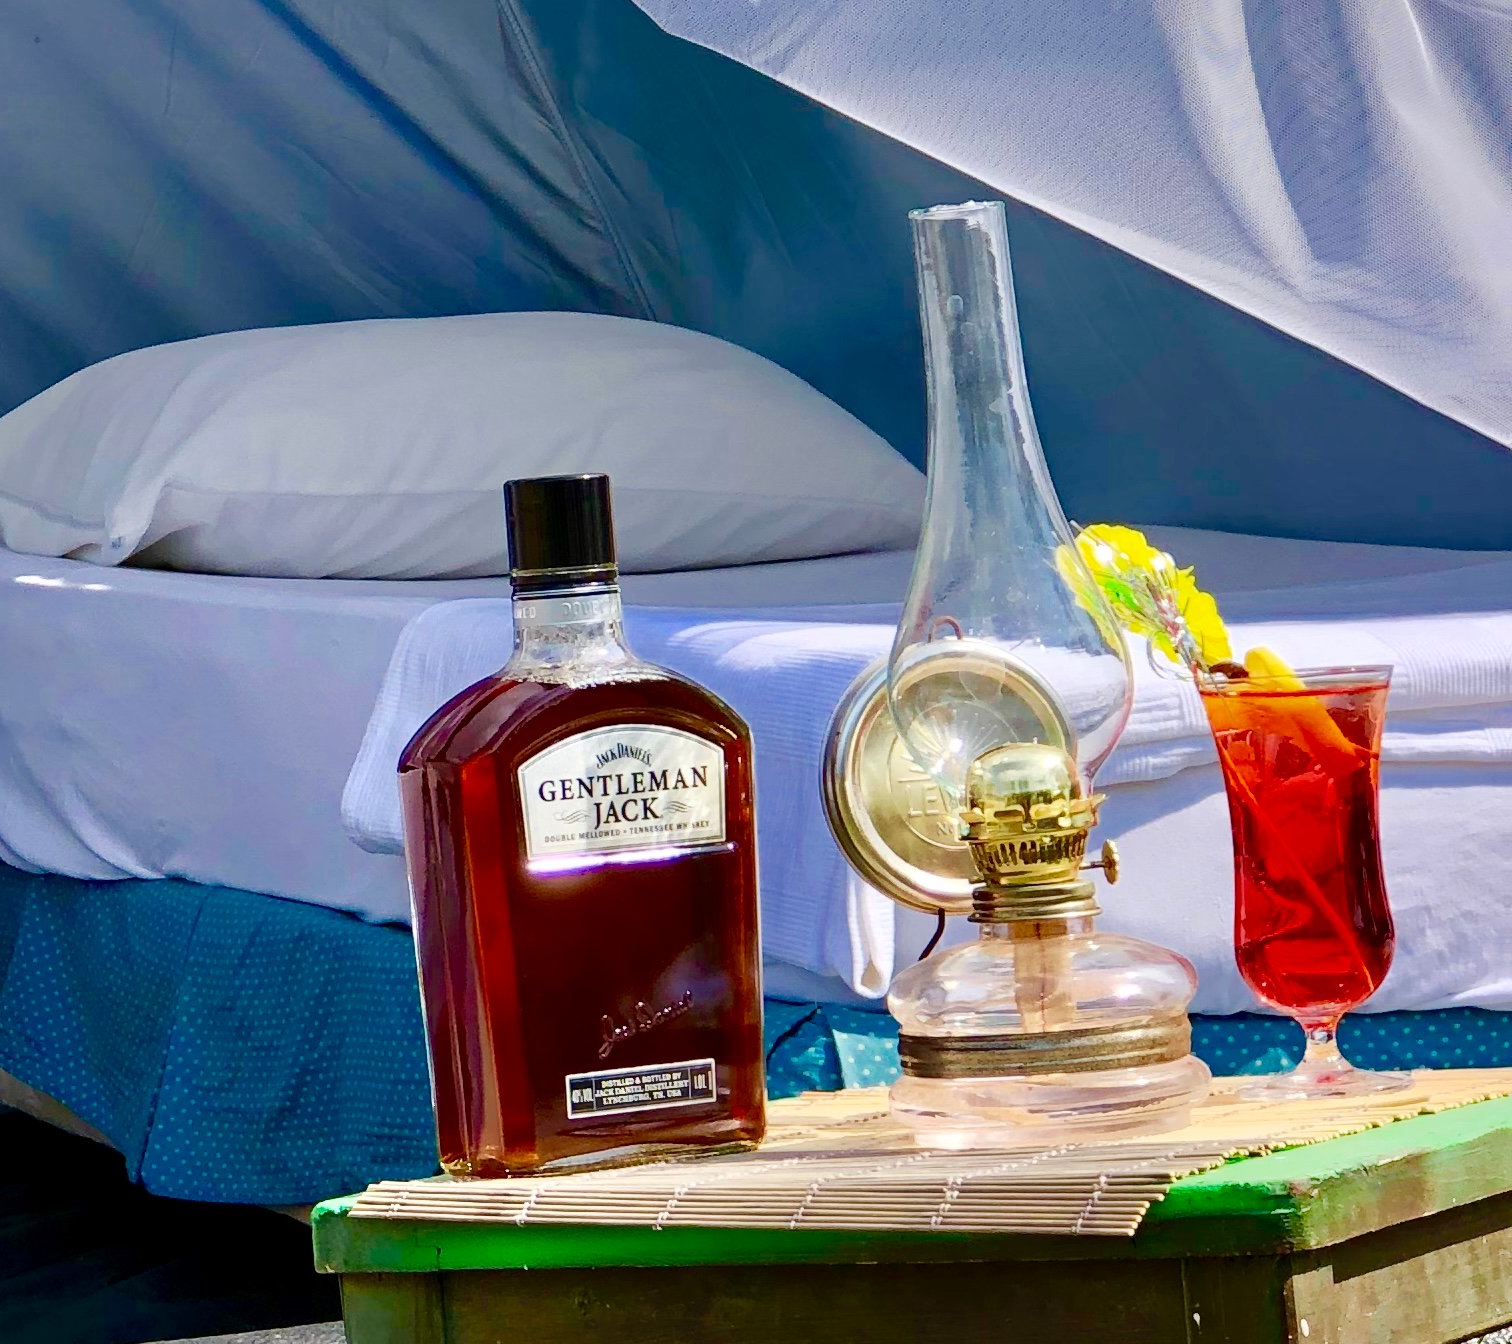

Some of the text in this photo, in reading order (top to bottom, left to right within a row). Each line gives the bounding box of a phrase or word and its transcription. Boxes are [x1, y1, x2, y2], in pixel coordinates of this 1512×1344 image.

[538, 765, 708, 803] GENTLEMAN
[593, 797, 661, 830] JACK
[544, 833, 576, 844] DOUBLE
[578, 829, 621, 840] MELLOWED
[629, 824, 674, 836] TENNESSEE
